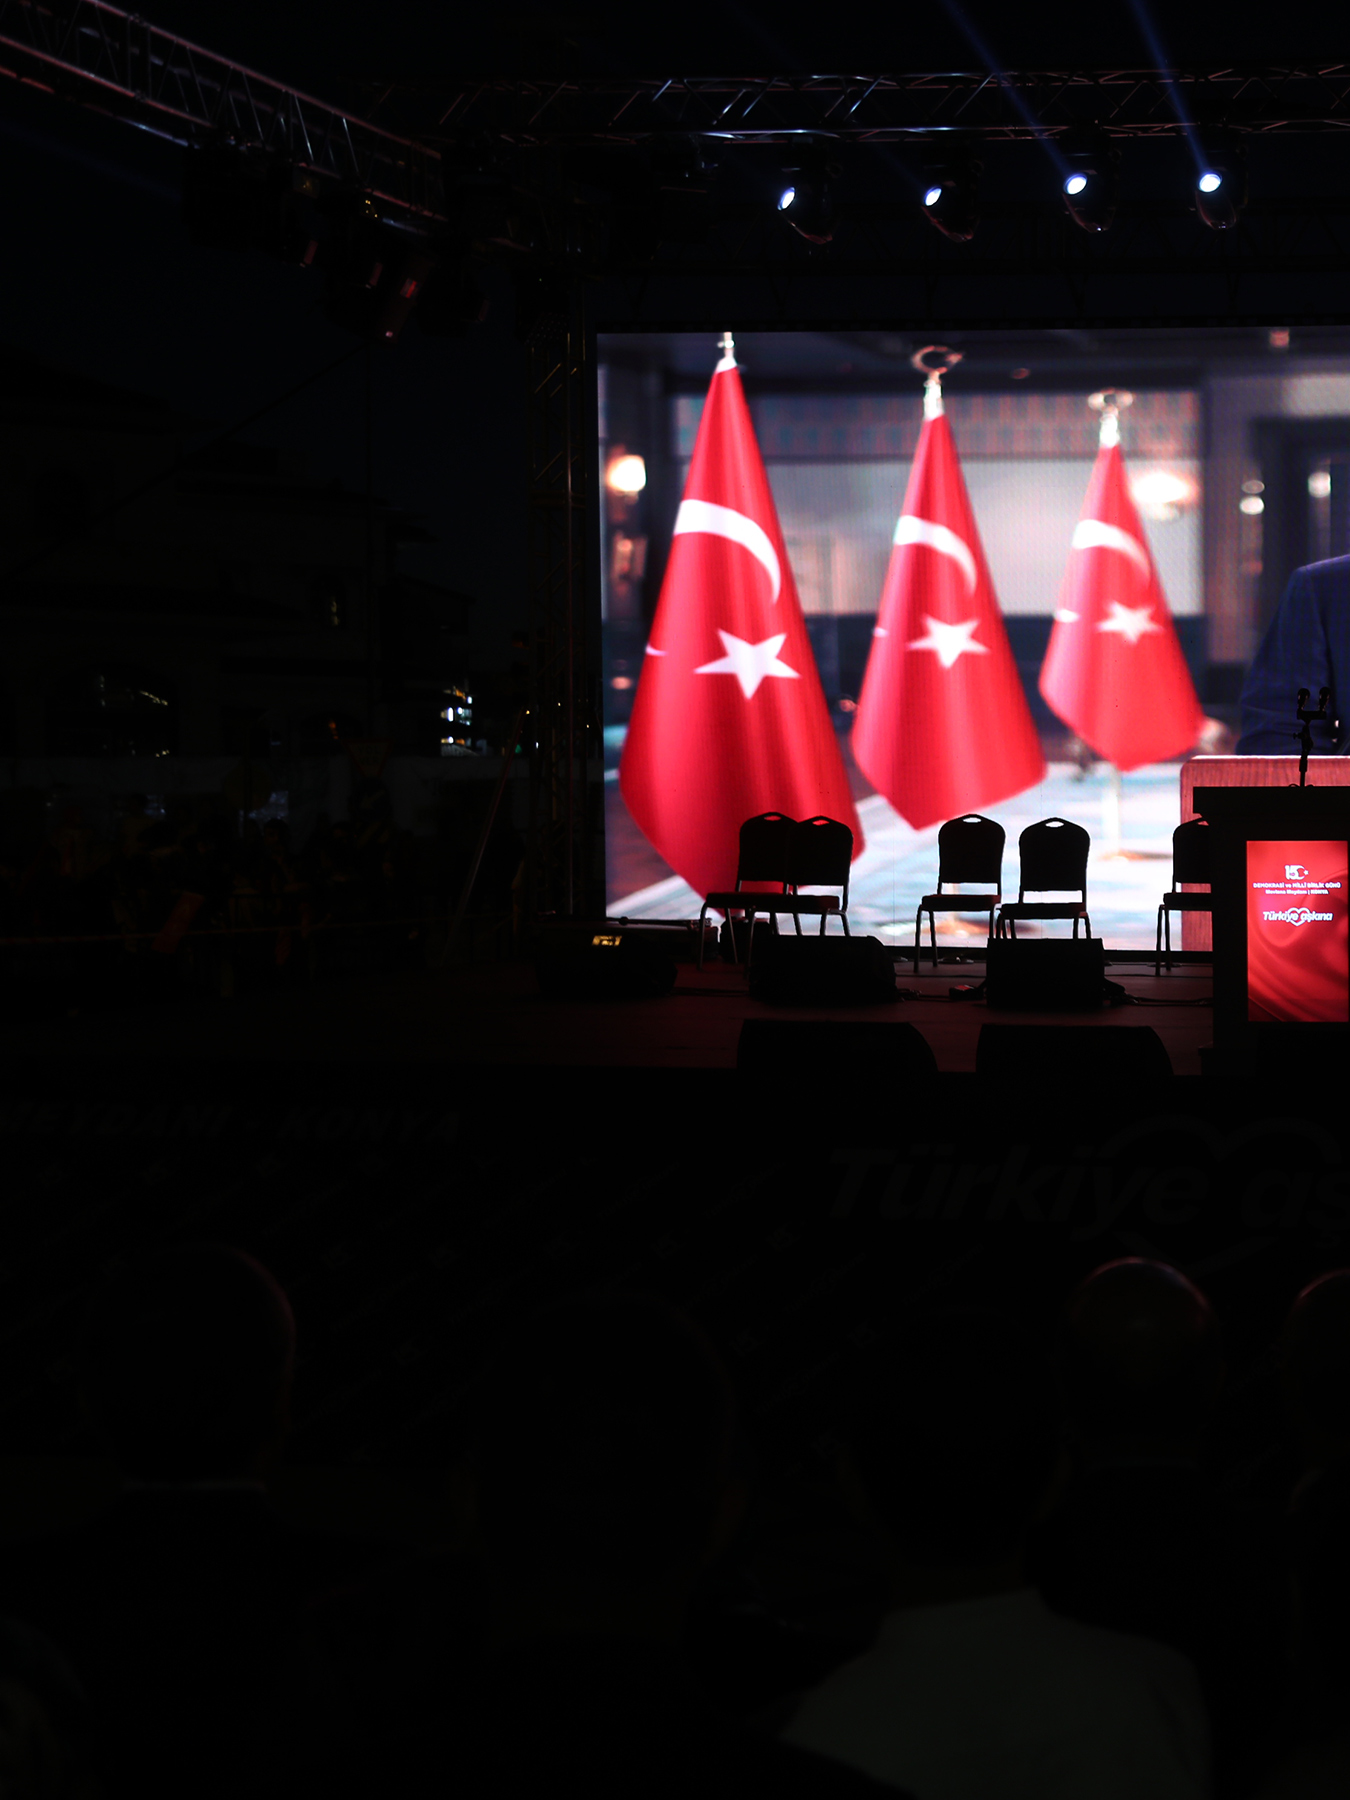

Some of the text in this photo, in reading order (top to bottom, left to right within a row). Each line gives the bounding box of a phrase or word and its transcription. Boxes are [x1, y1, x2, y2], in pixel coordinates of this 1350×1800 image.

[1263, 911, 1333, 922] Türkiye aşkına
[828, 1143, 1210, 1242] Türkiye
